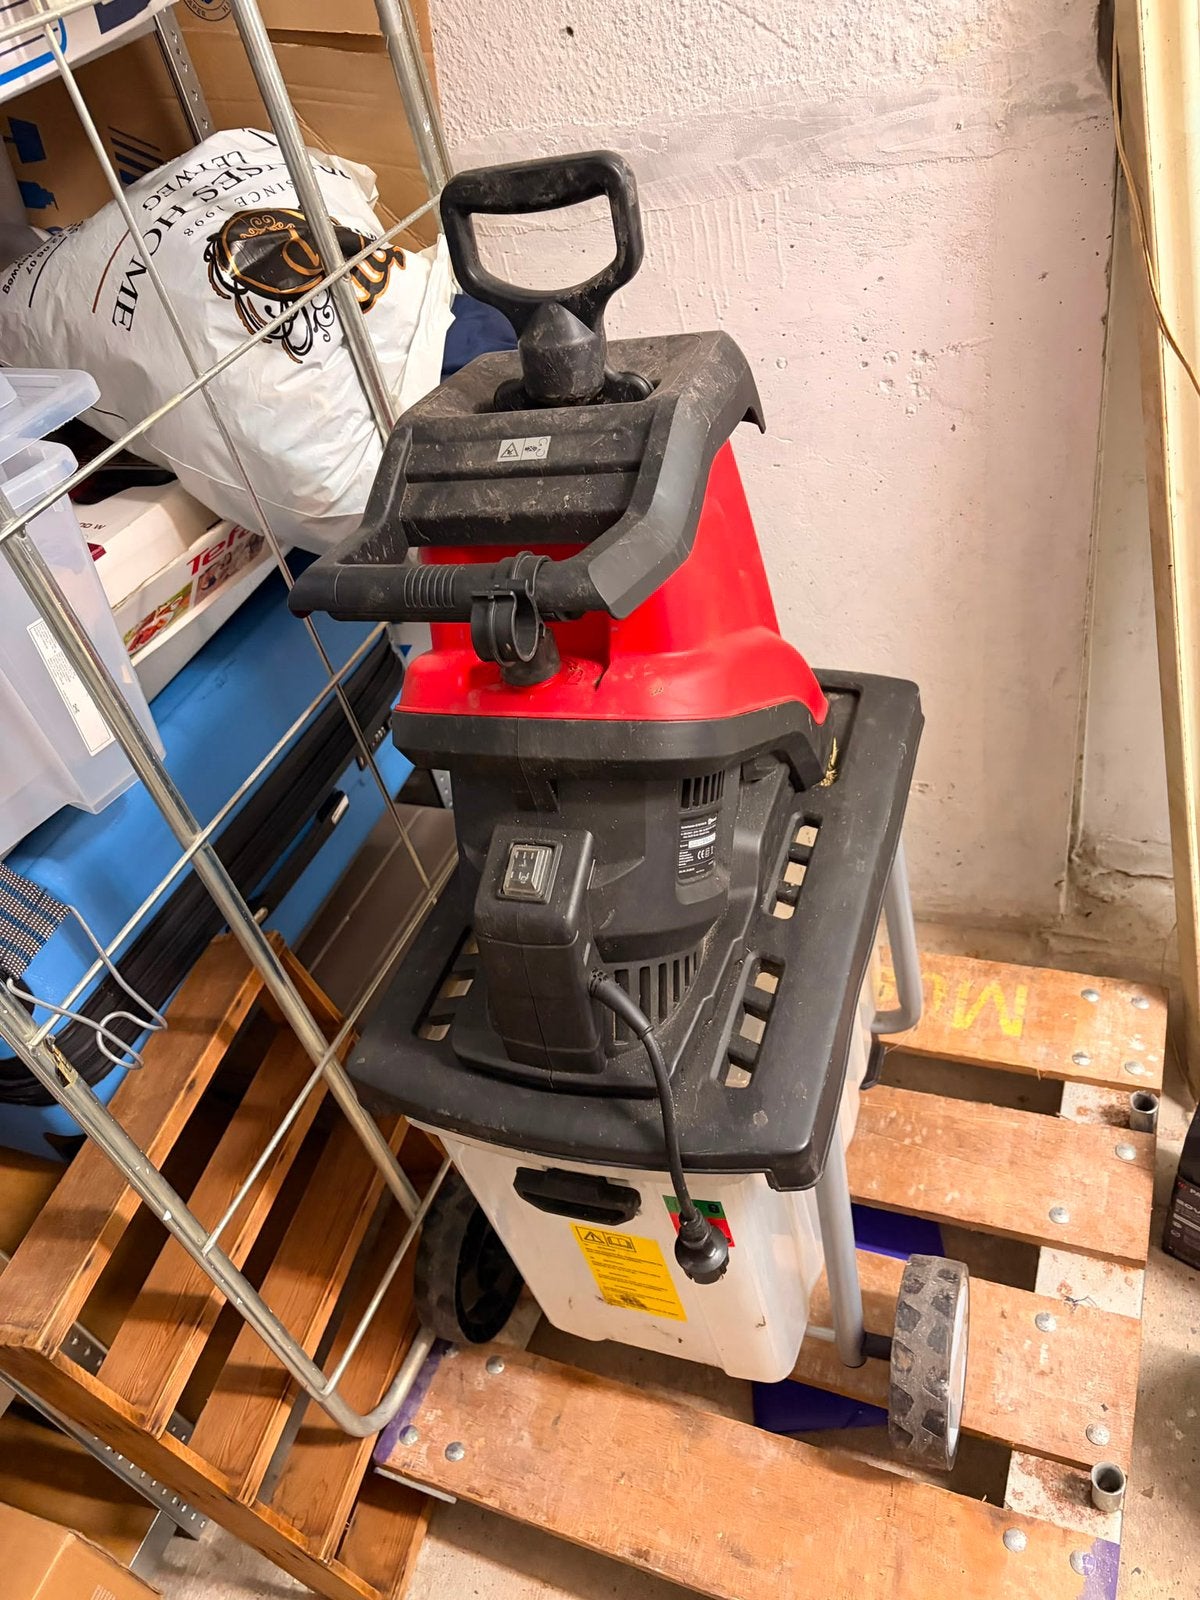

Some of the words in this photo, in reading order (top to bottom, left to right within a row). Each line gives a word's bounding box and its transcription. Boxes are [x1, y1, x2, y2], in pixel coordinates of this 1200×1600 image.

[142, 151, 249, 211] LEYWEG
[234, 179, 294, 208] SINCE
[183, 205, 225, 237] 1998
[26, 260, 37, 275] 07
[112, 204, 188, 332] HOME
